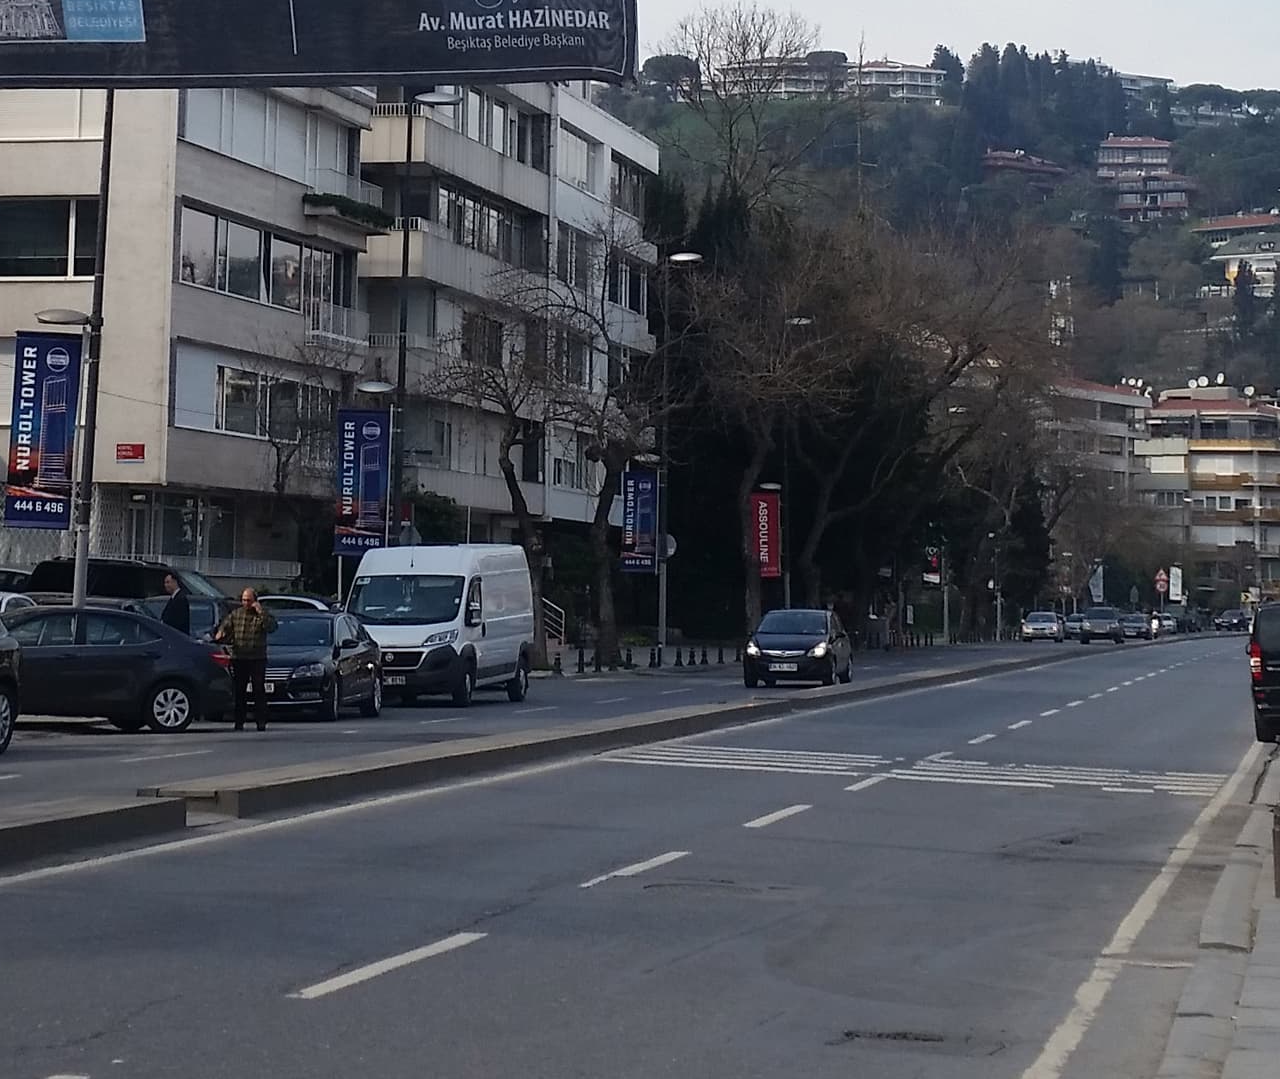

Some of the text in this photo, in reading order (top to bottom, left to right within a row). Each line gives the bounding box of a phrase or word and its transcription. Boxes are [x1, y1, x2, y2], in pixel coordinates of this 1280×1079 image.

[419, 5, 611, 31] Av. Murat HAZİNEDAR
[447, 33, 585, 52] Beşiktaş Belediye Başkanı
[16, 346, 38, 471] NUROLTOWER
[342, 421, 356, 515] NUROLTOWER
[14, 500, 64, 513] 444 6 496
[758, 500, 769, 563] ASSOULINE
